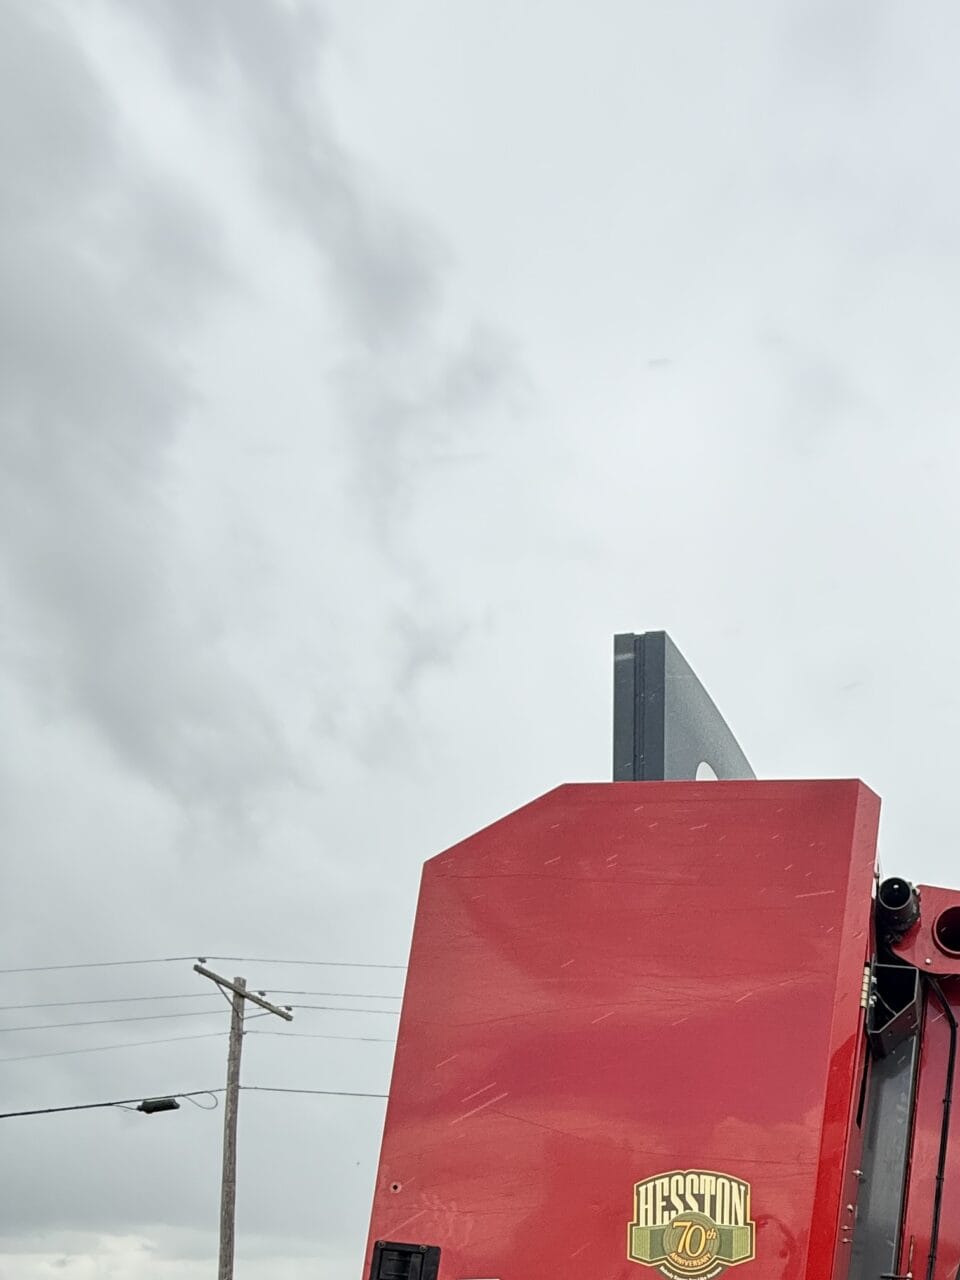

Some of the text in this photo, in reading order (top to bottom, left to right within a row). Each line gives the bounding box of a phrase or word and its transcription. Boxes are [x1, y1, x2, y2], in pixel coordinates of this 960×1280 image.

[638, 1174, 746, 1227] HESSTON
[672, 1221, 717, 1257] 70th
[669, 1252, 712, 1267] ANNIVERSARY
